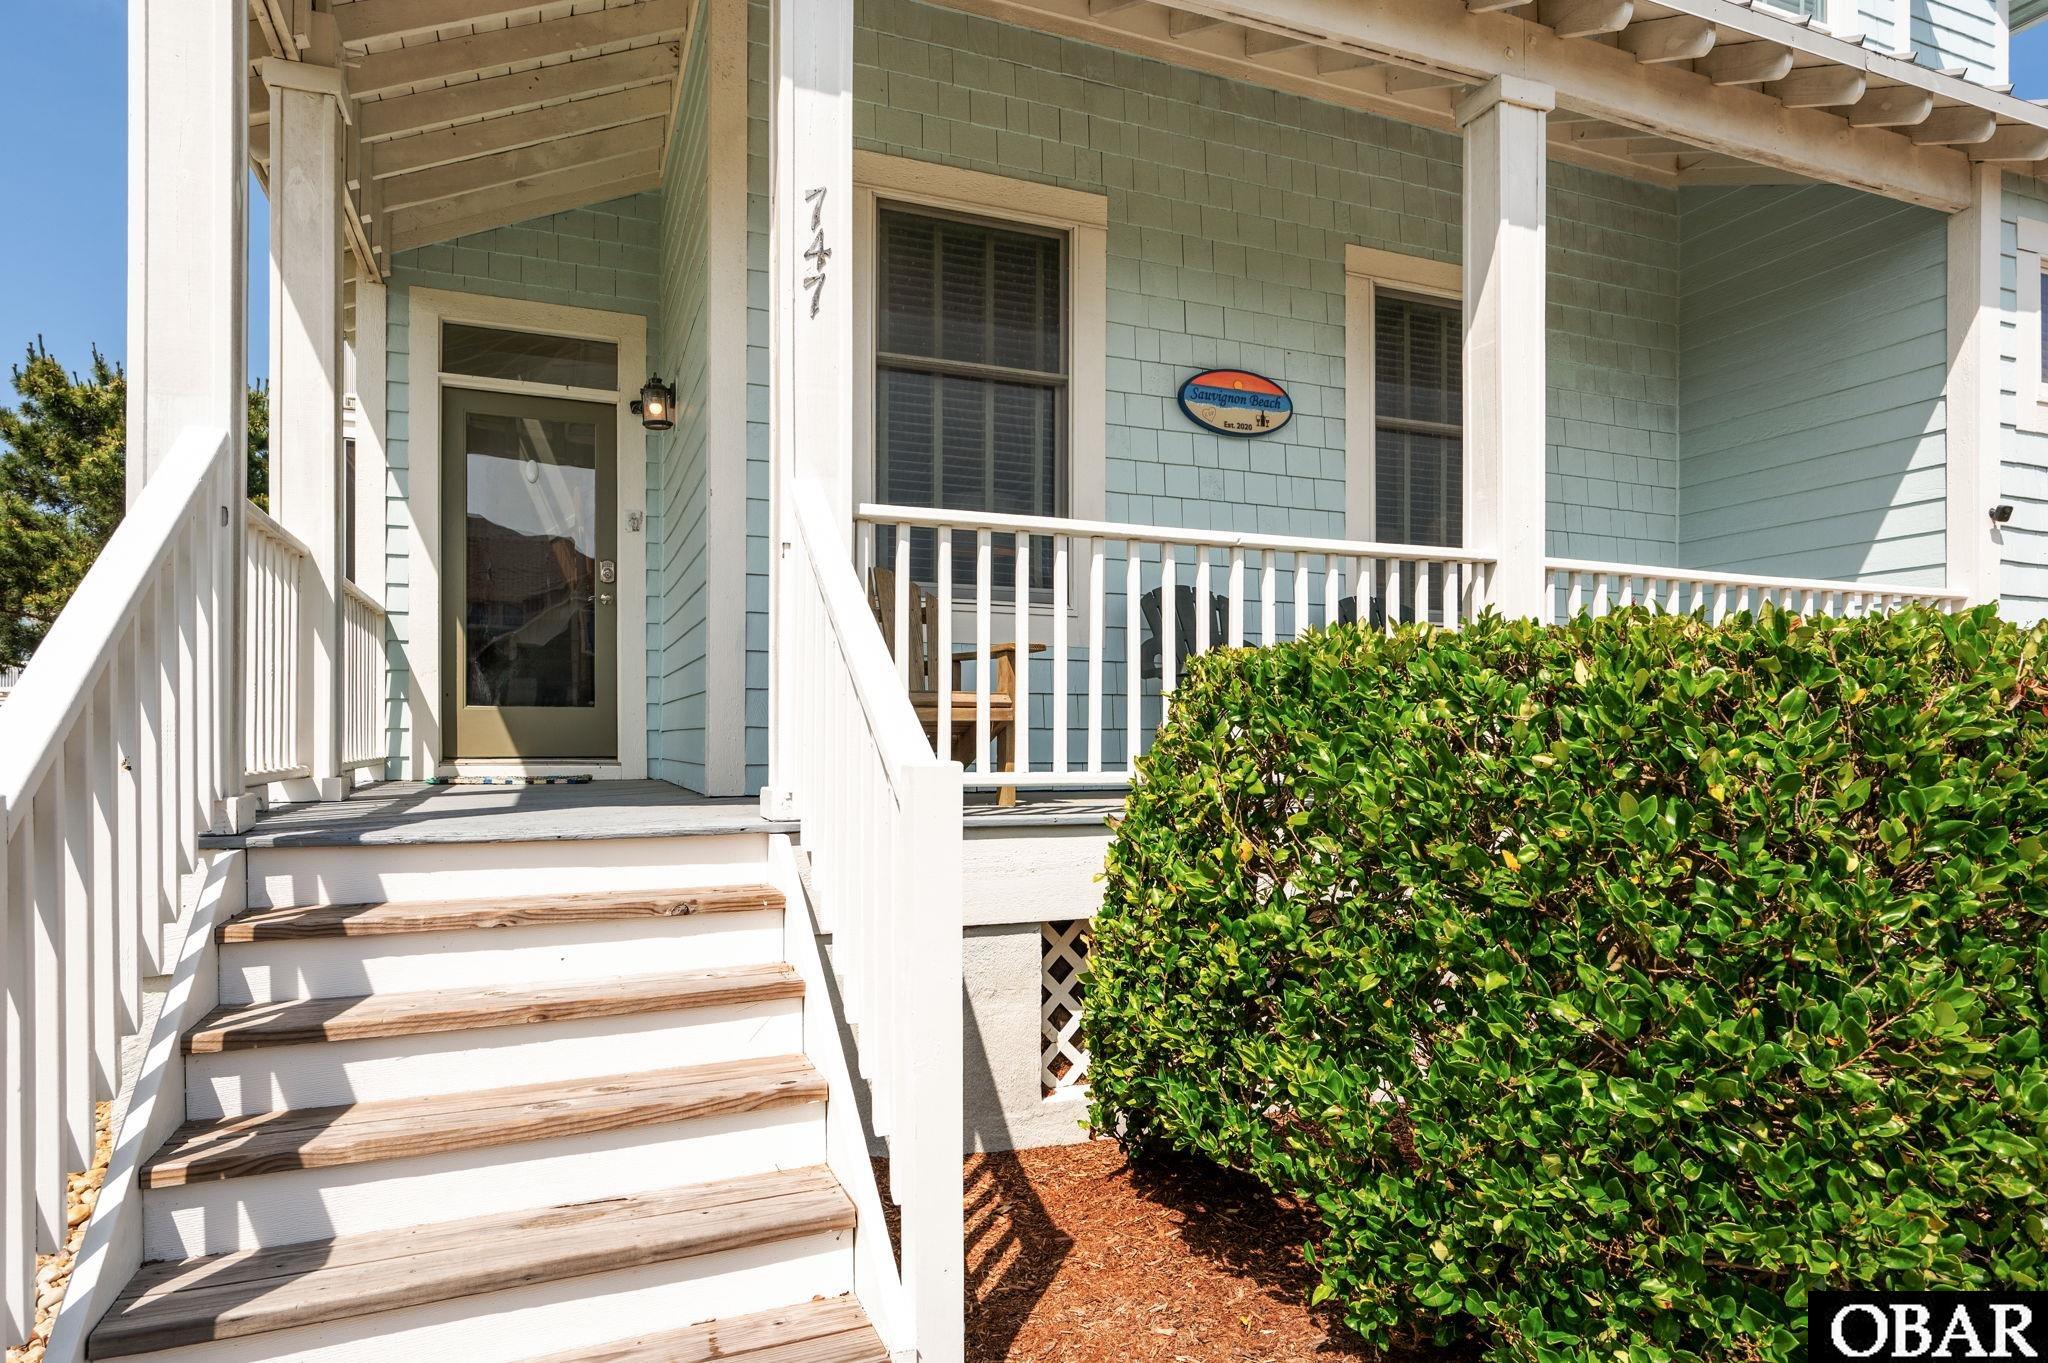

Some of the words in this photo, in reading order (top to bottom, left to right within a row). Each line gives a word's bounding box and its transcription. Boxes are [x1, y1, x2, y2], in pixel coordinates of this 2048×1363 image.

[804, 187, 832, 320] 747
[1190, 387, 1247, 406] Sauvignon
[1249, 395, 1281, 409] Beach
[1223, 421, 1235, 429] Est.
[1236, 422, 1253, 431] 2020
